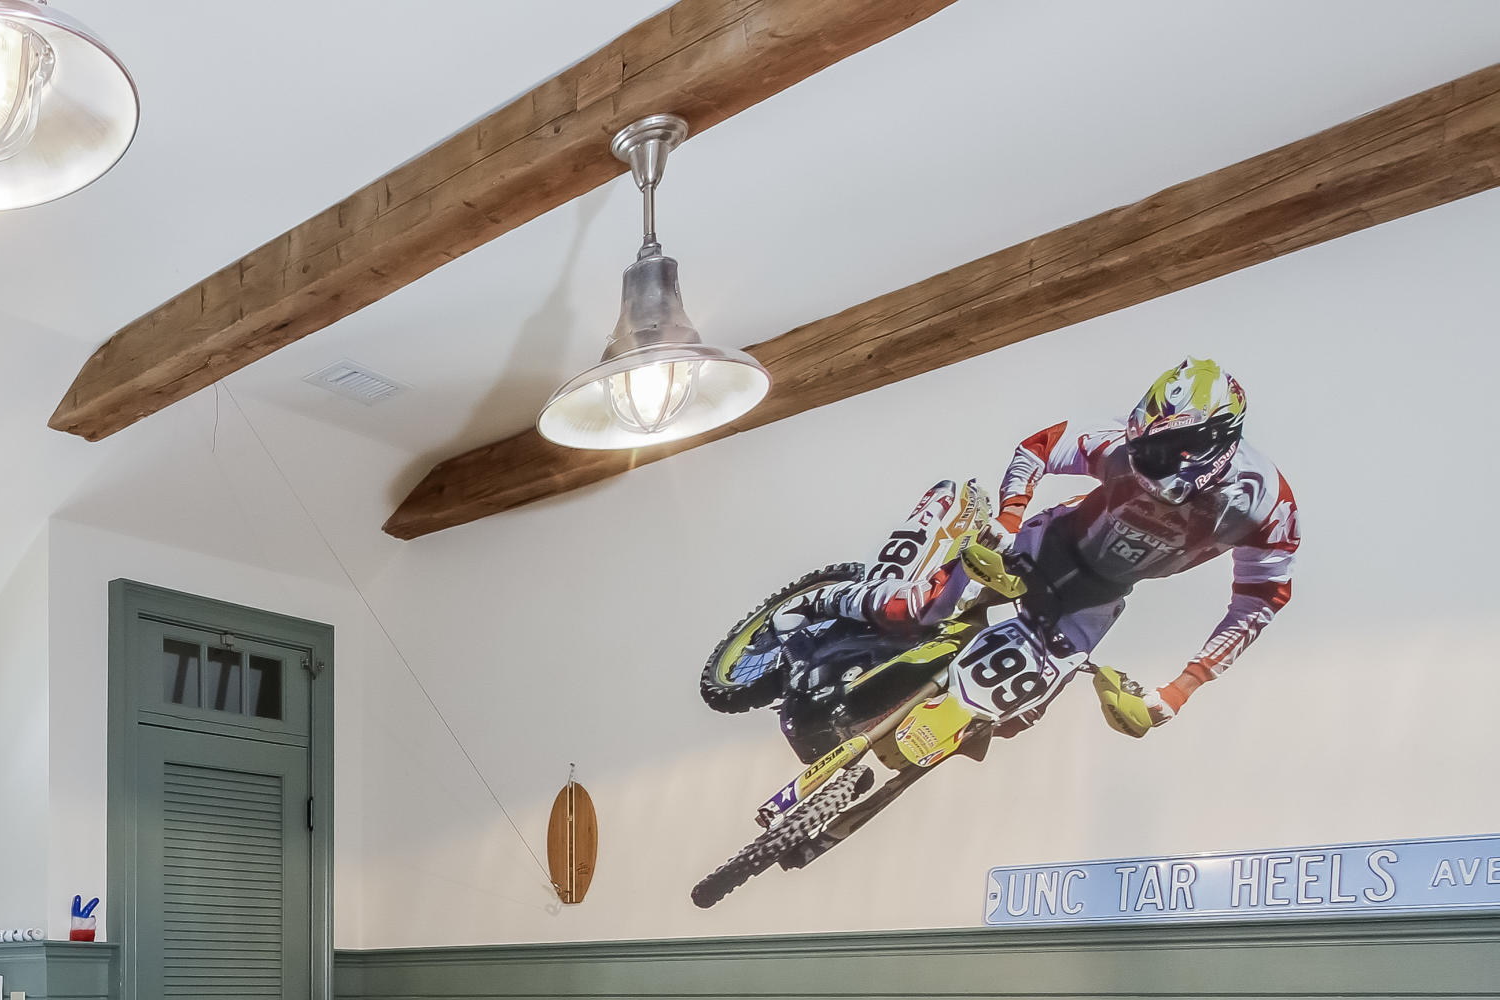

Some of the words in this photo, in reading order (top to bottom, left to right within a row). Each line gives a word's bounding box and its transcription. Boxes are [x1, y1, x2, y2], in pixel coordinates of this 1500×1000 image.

[958, 631, 1048, 712] 199
[804, 745, 845, 780] WISECO
[1006, 868, 1087, 917] UNC
[1115, 863, 1197, 912] TAR
[1230, 849, 1399, 907] HEELS
[1431, 856, 1500, 888] AVE
